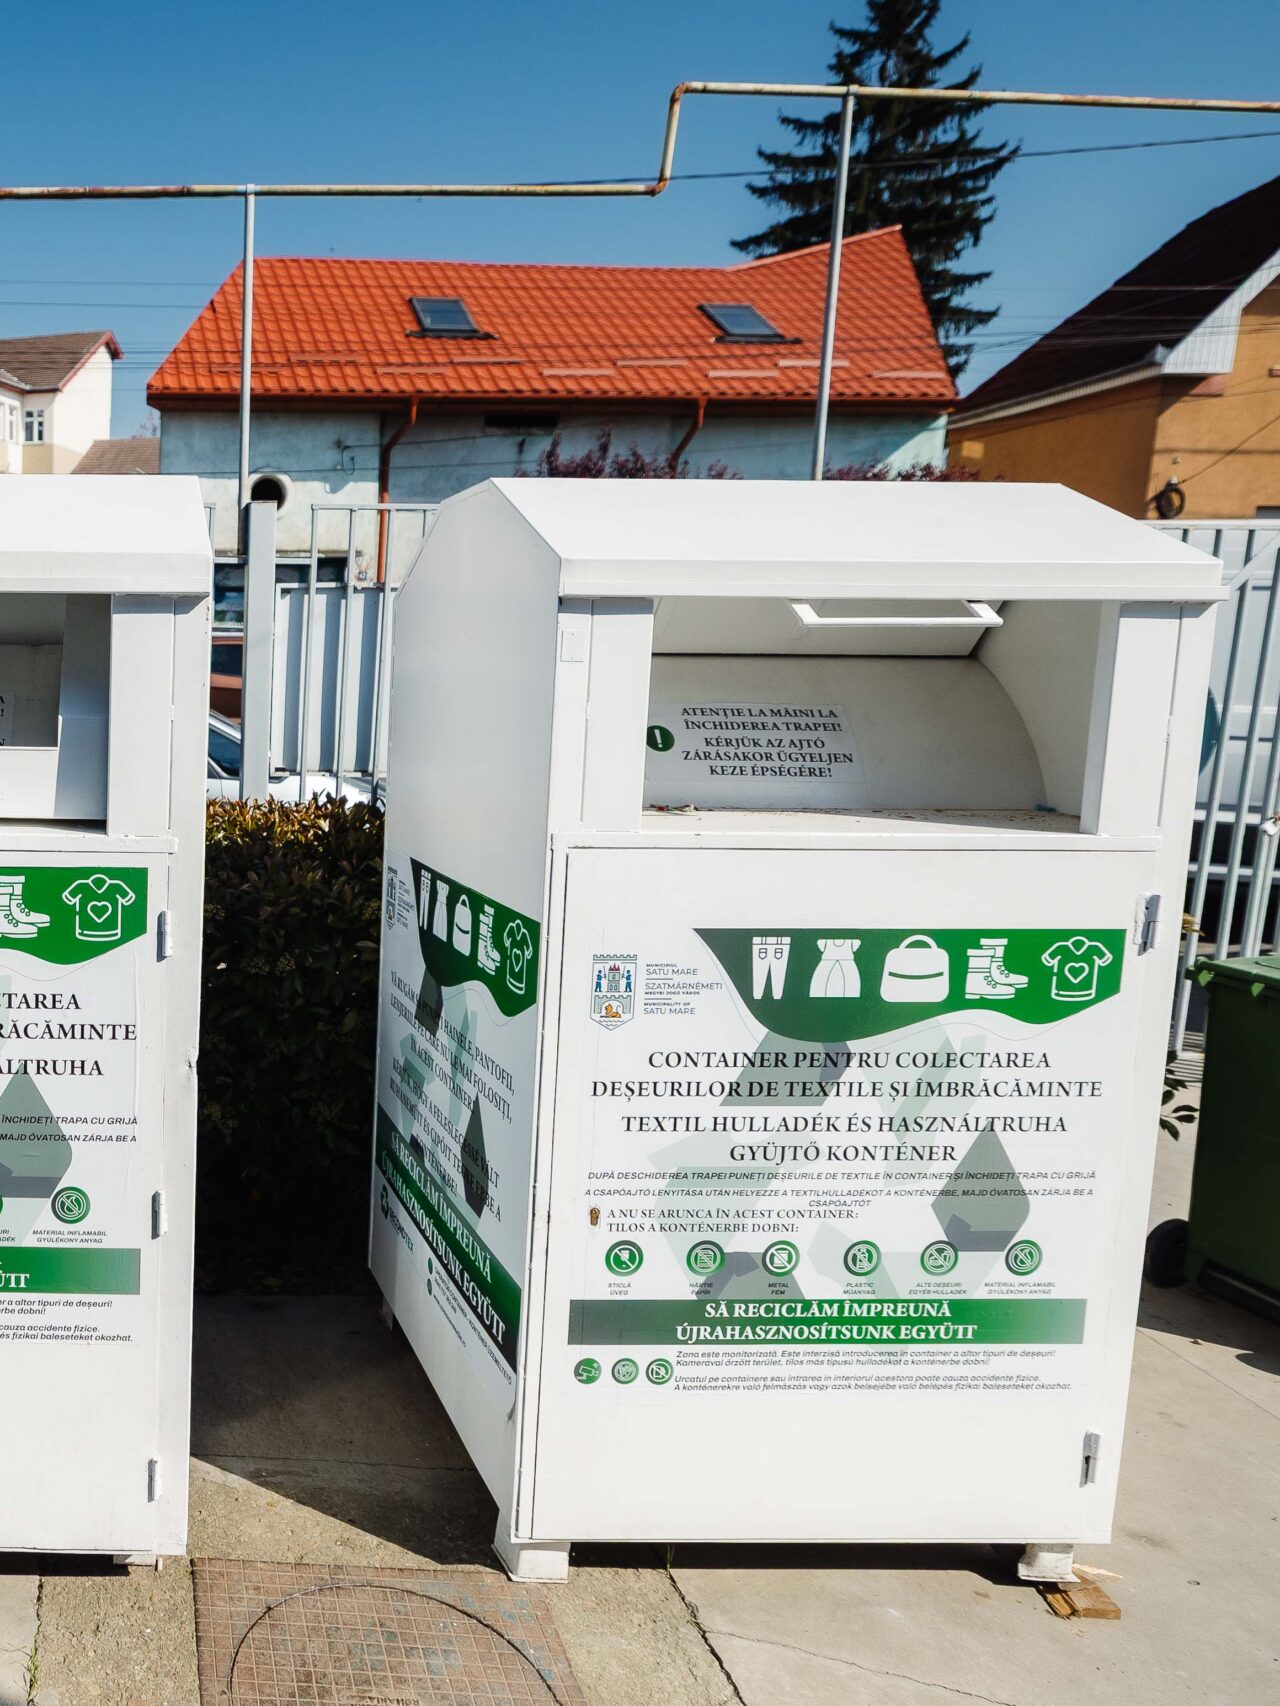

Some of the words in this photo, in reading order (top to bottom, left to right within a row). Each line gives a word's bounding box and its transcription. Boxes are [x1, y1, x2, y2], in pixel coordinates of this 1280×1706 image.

[748, 708, 767, 717] LA
[770, 707, 815, 718] MÂINI
[818, 709, 838, 718] LA
[685, 719, 779, 731] ÎNCHIDEREA
[784, 722, 843, 732] TRAPEI!
[704, 736, 763, 750] KÉRJÜK
[766, 739, 785, 748] AZ
[788, 736, 825, 751] AJTÓ
[682, 748, 775, 762] ZÁRÁSAKOR
[777, 750, 852, 765] ÜGYELJEN
[710, 765, 748, 776] KEZE
[751, 764, 832, 777] ÉPSÉGÉRE!
[646, 966, 669, 975] SATU
[672, 966, 698, 975] MARE
[645, 980, 723, 991] SZATMÁRNÉMETI
[649, 1052, 788, 1068] CONTAINER
[794, 1052, 889, 1068] PENTRU
[896, 1052, 1050, 1068] COLECTAREA
[592, 1081, 742, 1101] DEȘEURILOR
[748, 1082, 778, 1097] DE
[785, 1082, 883, 1097] TEXTILE
[889, 1082, 909, 1102] ȘI
[915, 1078, 1102, 1097] ÎMBRĂCĂMINTE
[622, 1117, 706, 1132] TEXTIL
[712, 1113, 840, 1132] HULLADÉK
[847, 1113, 871, 1132] ÉS
[878, 1113, 1066, 1132] HASZNÁLTRUHA
[730, 1141, 820, 1165] GYÜJTŐ
[828, 1142, 956, 1161] KONTÉNER
[608, 1210, 615, 1218] A
[619, 1210, 638, 1218] NU
[641, 1209, 655, 1218] SE
[658, 1210, 712, 1218] ARUNCA
[716, 1208, 730, 1218] ÎN
[733, 1210, 774, 1218] ACEST
[777, 1210, 858, 1218] CONTAINER:
[608, 1223, 644, 1232] TILOS
[648, 1224, 656, 1232] A
[660, 1222, 748, 1232] KONTÉNERBE
[752, 1224, 798, 1232] DOBNI:
[705, 1301, 730, 1317] SĂ
[733, 1300, 840, 1317] RECICLĂM
[842, 1300, 952, 1317] ÎMPREUNĂ
[676, 1322, 896, 1342] ÚJRAHASZNOSÍTSUNK
[898, 1322, 977, 1339] EGYÜTT
